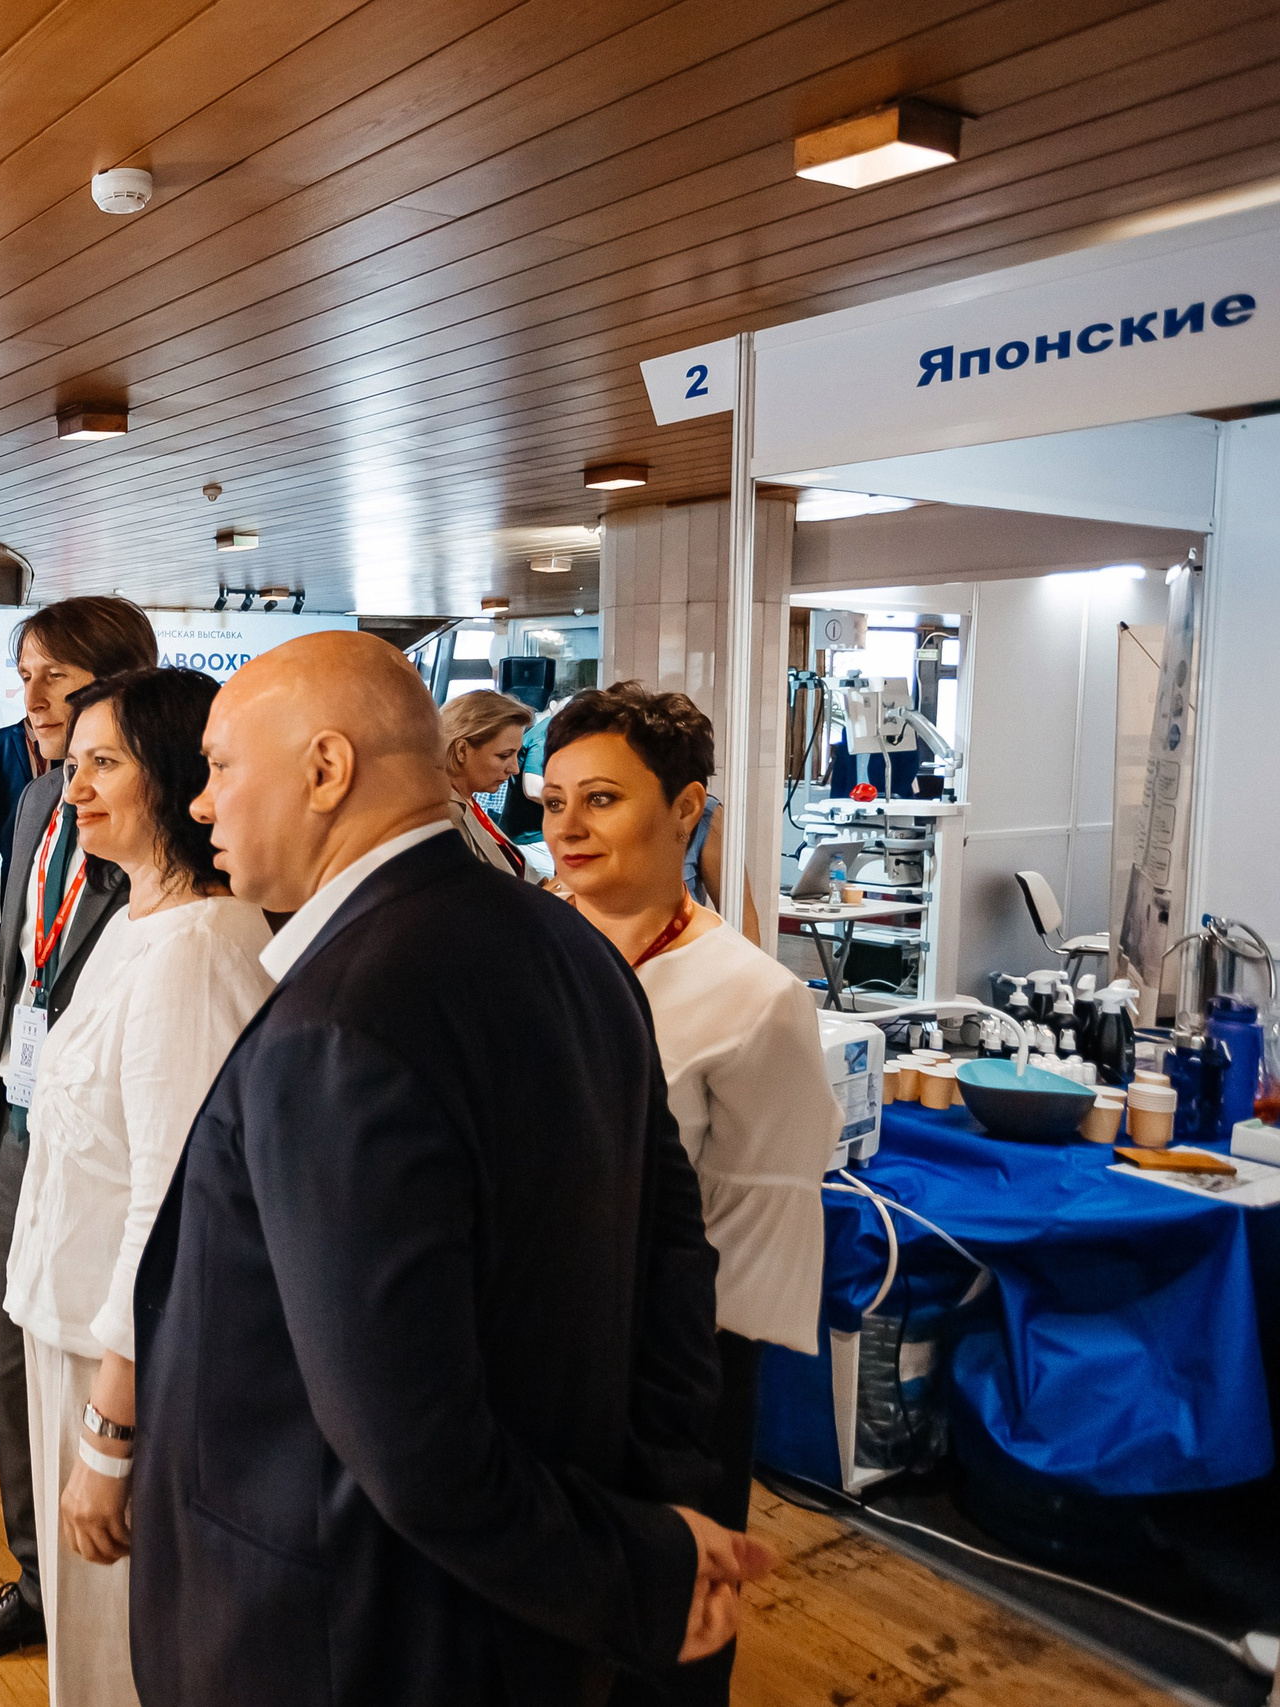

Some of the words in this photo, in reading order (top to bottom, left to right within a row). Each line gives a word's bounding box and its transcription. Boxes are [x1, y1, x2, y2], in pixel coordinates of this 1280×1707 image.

[916, 292, 1258, 388] Японские
[685, 364, 709, 399] 2
[197, 630, 243, 639] ВЫСТАВКА
[159, 652, 260, 671] АВООХР
